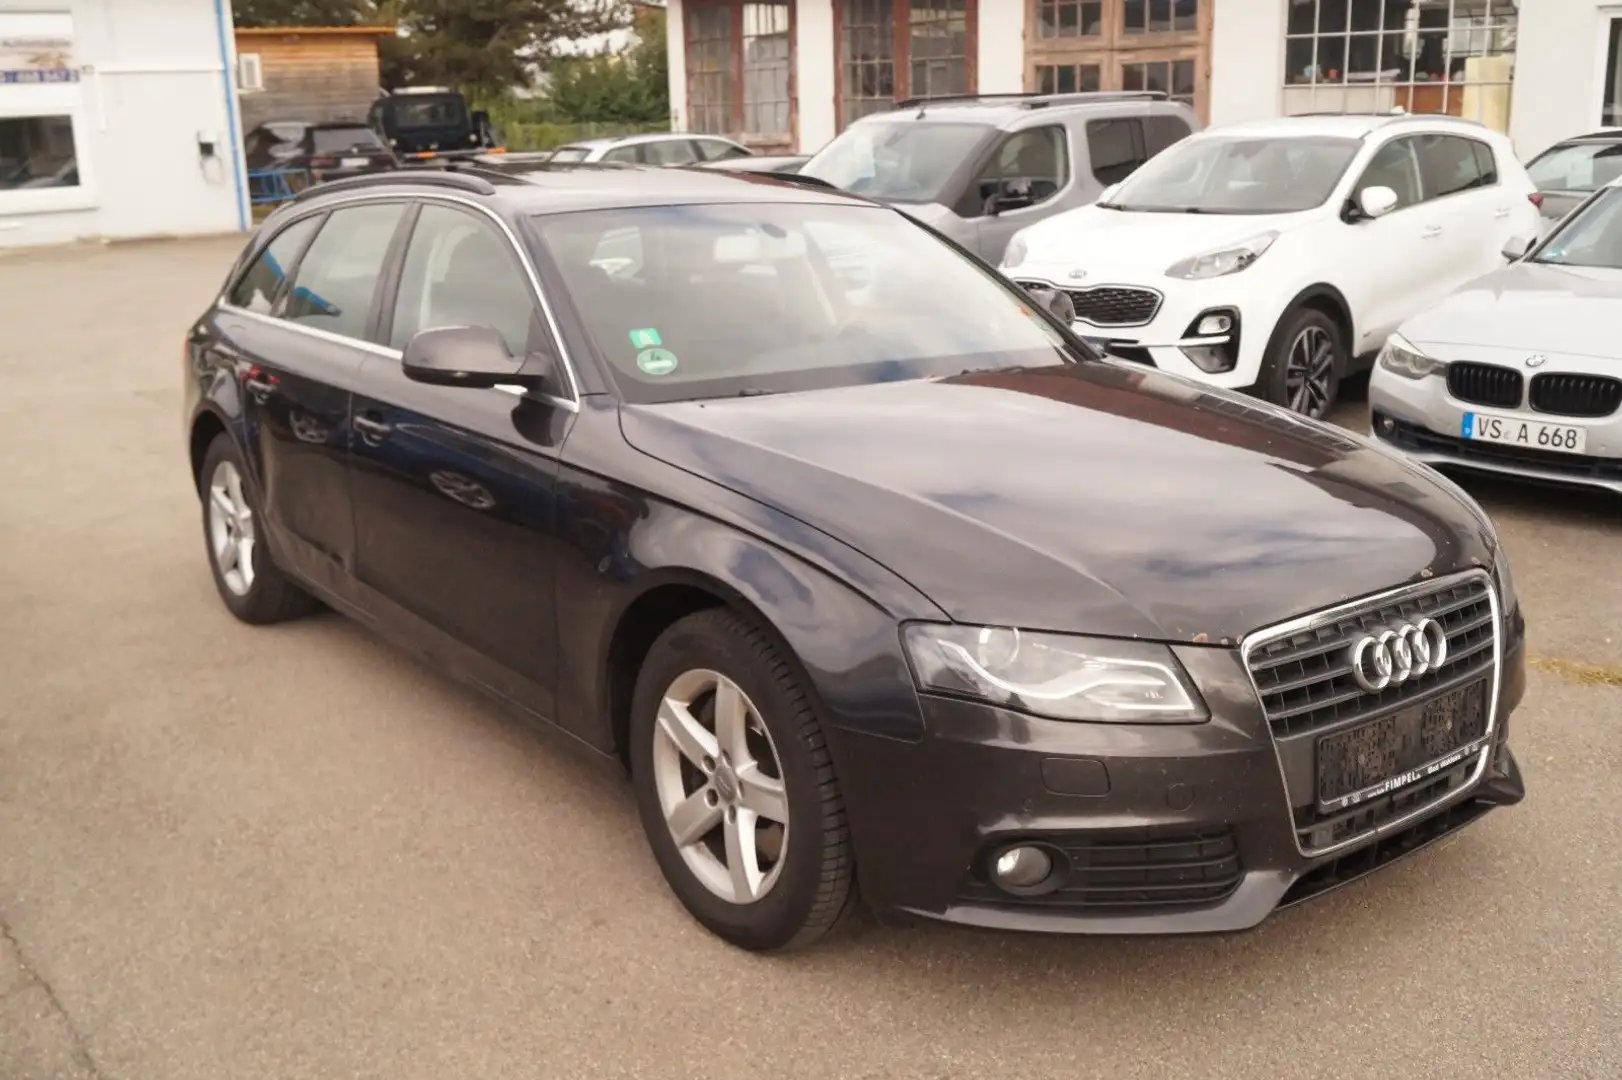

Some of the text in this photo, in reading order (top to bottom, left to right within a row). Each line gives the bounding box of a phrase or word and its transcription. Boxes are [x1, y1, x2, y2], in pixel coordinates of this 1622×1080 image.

[1477, 417, 1577, 449] VS A 668
